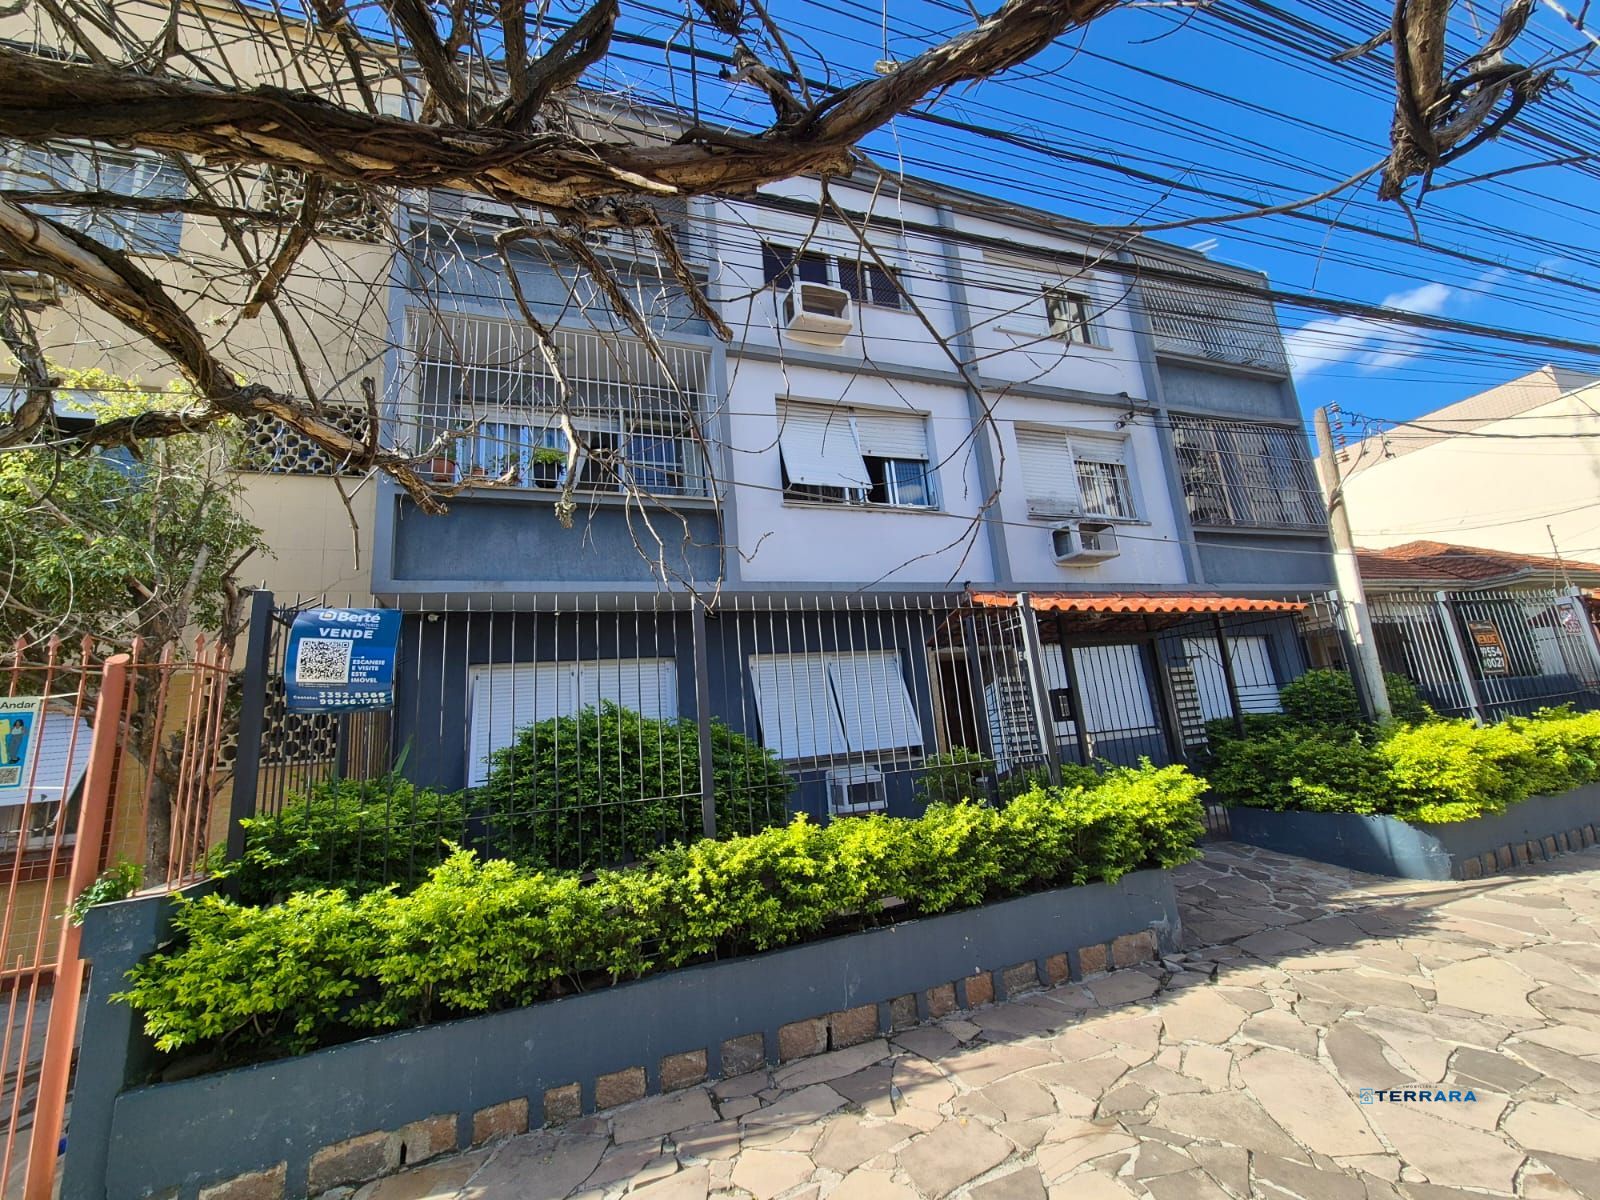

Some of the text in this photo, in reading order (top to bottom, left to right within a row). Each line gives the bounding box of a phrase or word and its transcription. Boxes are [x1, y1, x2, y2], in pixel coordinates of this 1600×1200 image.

[337, 611, 380, 623] Berté
[319, 627, 374, 639] VENDE
[0, 701, 36, 709] Andar
